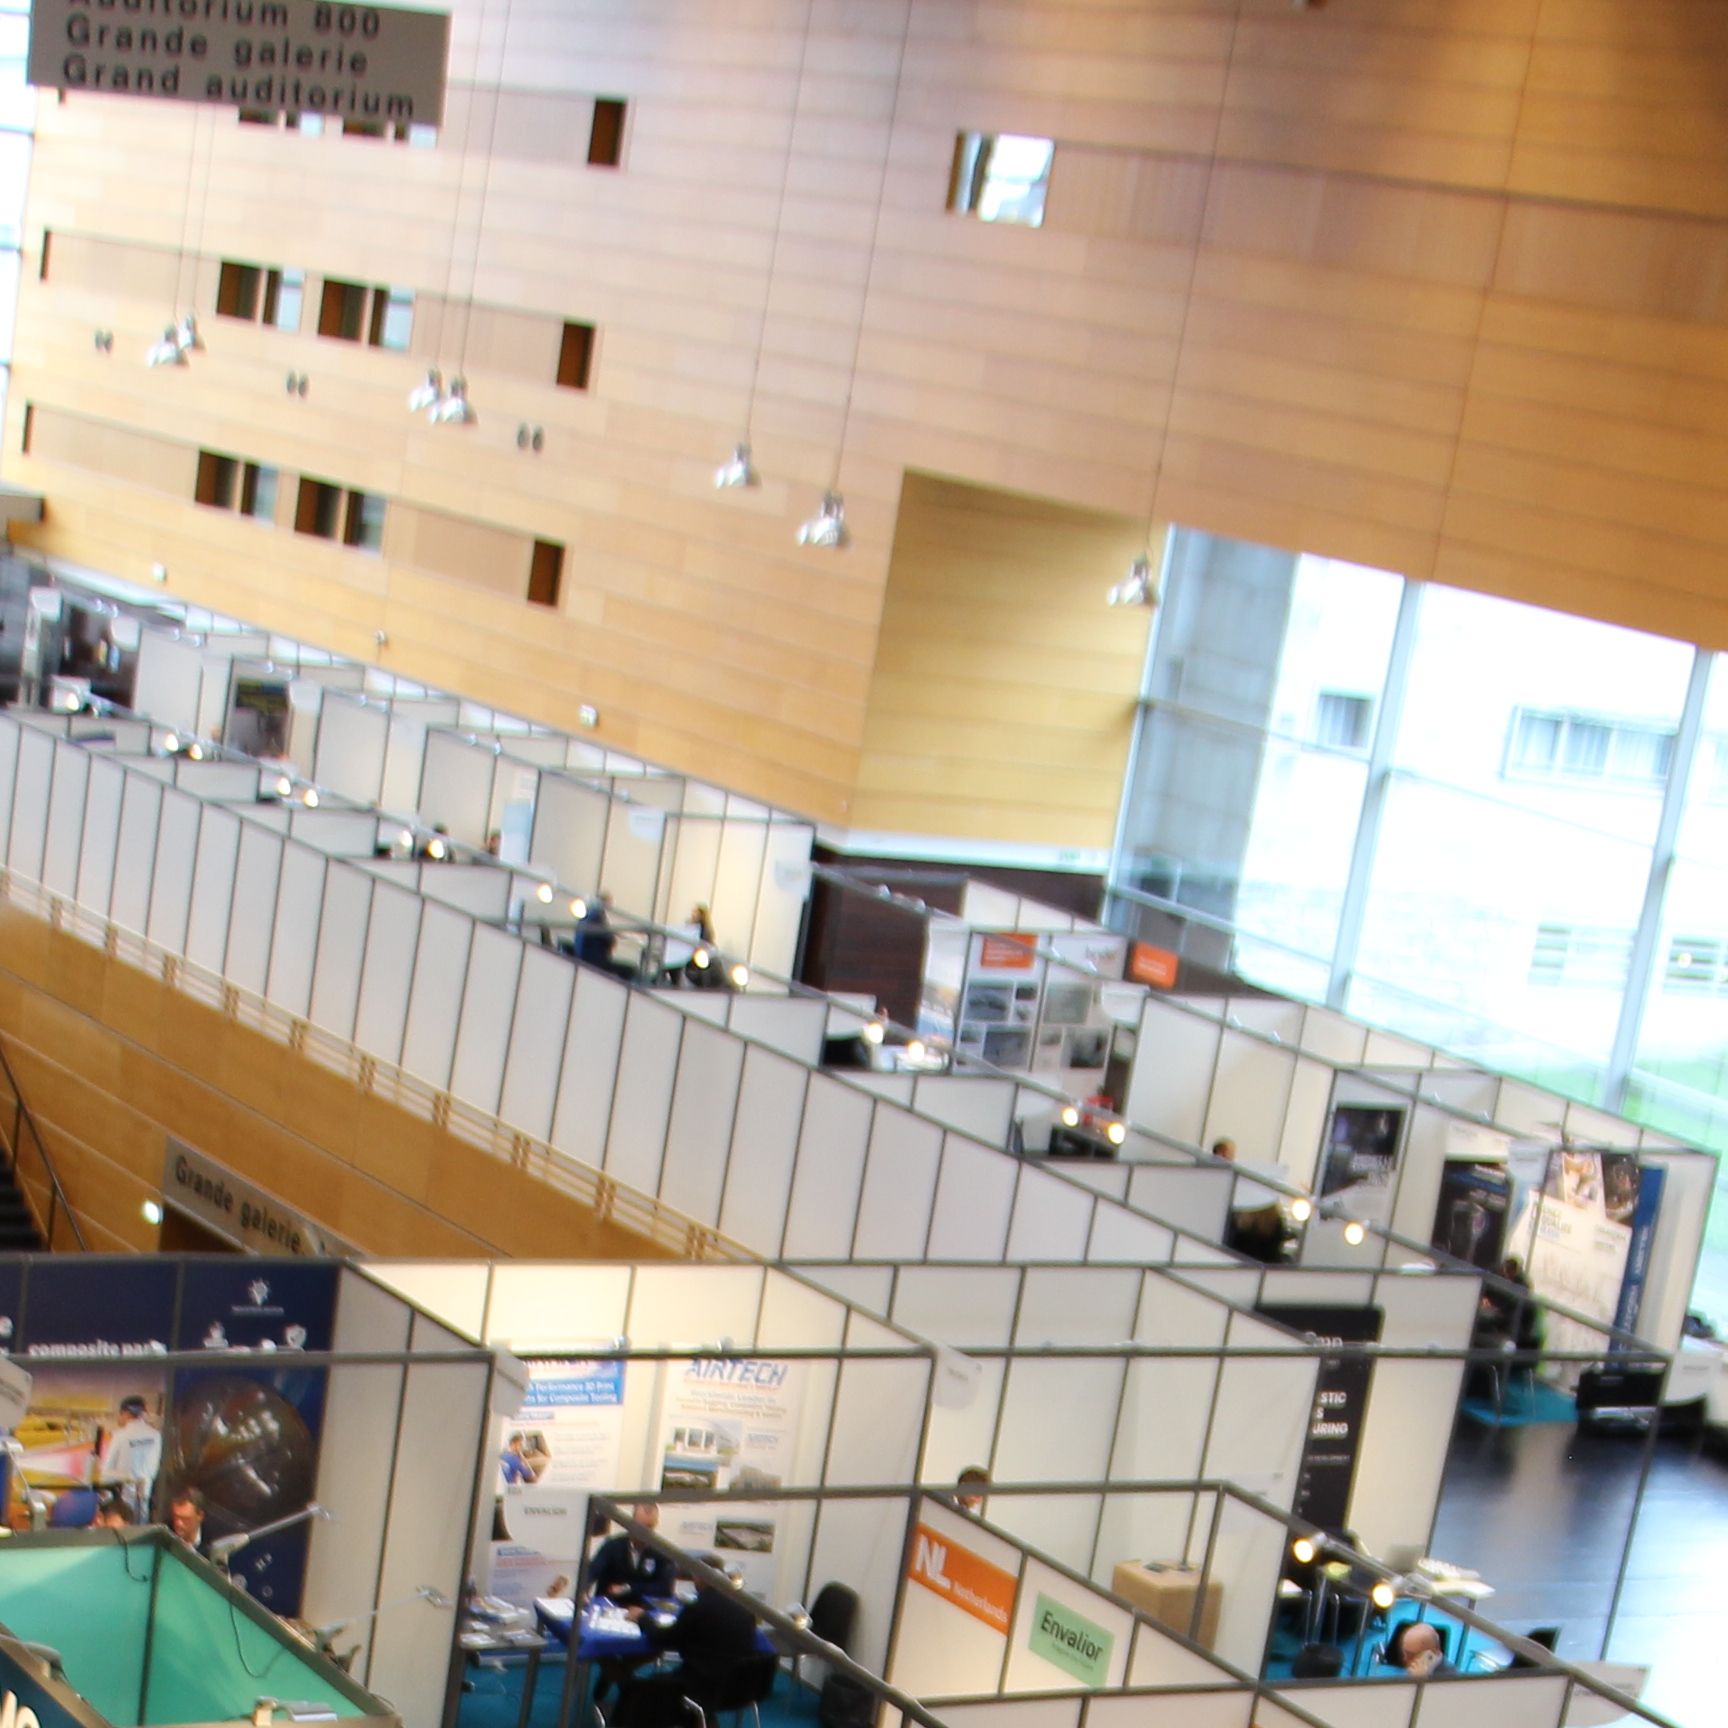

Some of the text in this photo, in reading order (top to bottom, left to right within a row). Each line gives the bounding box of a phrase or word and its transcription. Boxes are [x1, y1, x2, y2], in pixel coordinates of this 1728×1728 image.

[71, 0, 381, 38] uditorium 800
[66, 12, 368, 77] Grande galerie
[62, 53, 414, 117] Grand auditorium
[175, 1154, 302, 1253] Grande galerie
[28, 1338, 119, 1357] composite
[683, 1359, 788, 1387] AIRTECH
[953, 1582, 1008, 1624] Netherlands
[1040, 1610, 1104, 1661] Envalior
